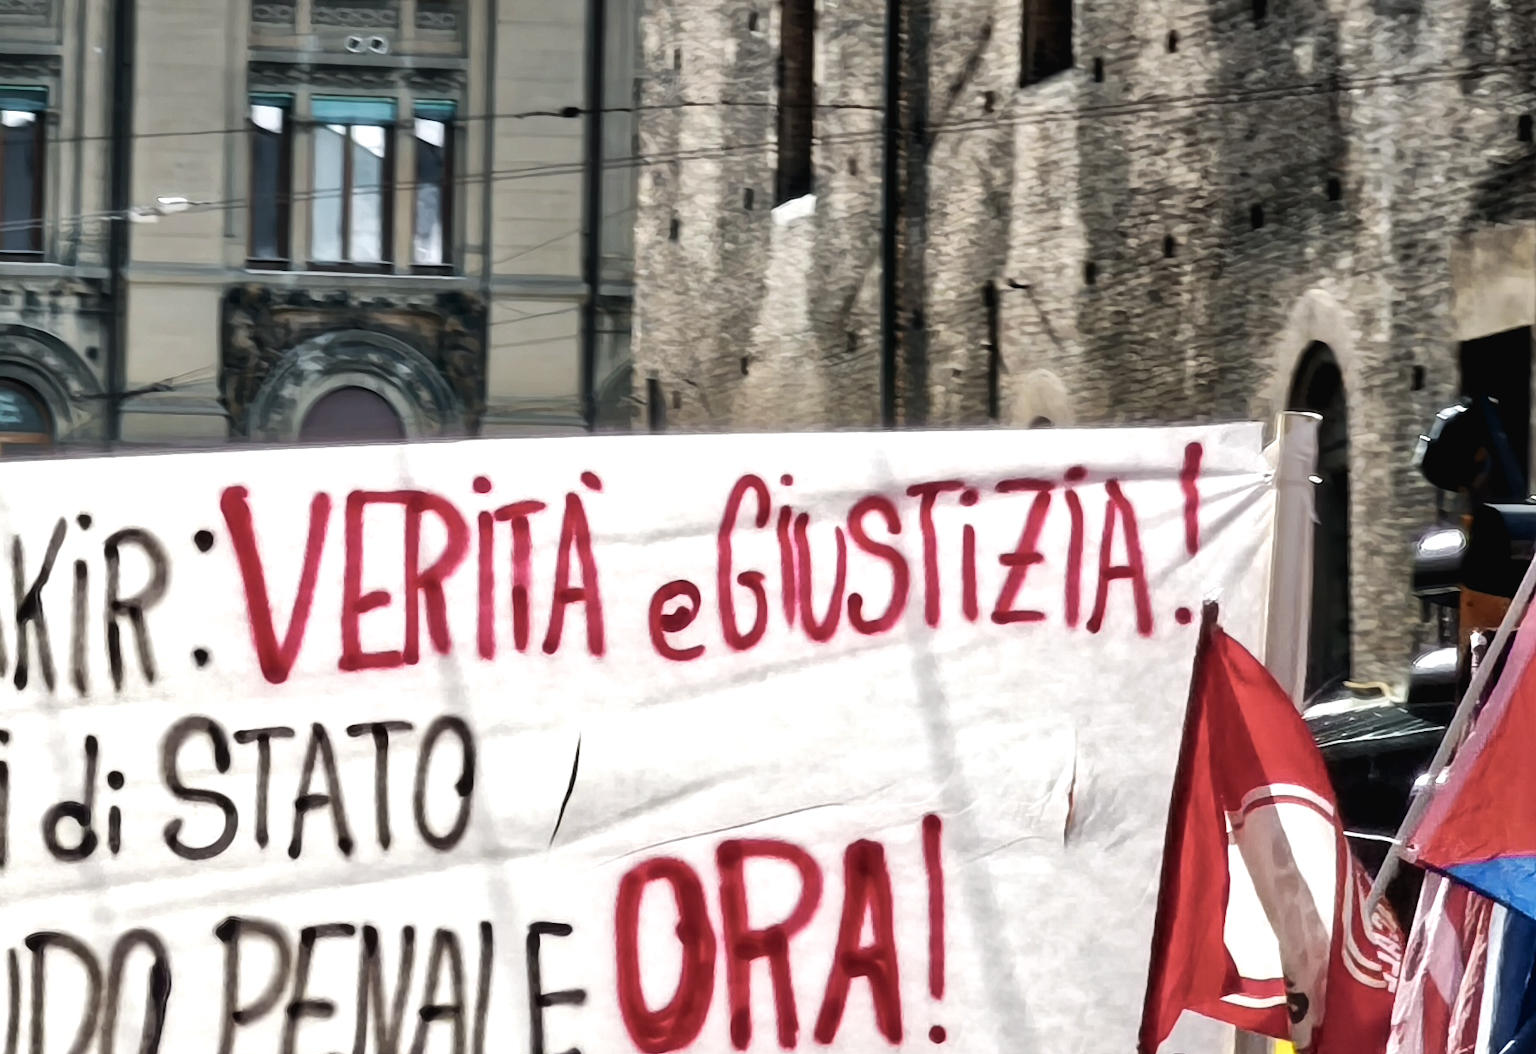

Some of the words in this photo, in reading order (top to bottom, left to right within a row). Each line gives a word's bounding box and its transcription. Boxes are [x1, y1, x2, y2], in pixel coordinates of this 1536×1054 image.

[649, 579, 706, 661] e
[42, 735, 125, 862] di
[158, 714, 477, 860] STATO
[615, 812, 947, 1054] ORA!
